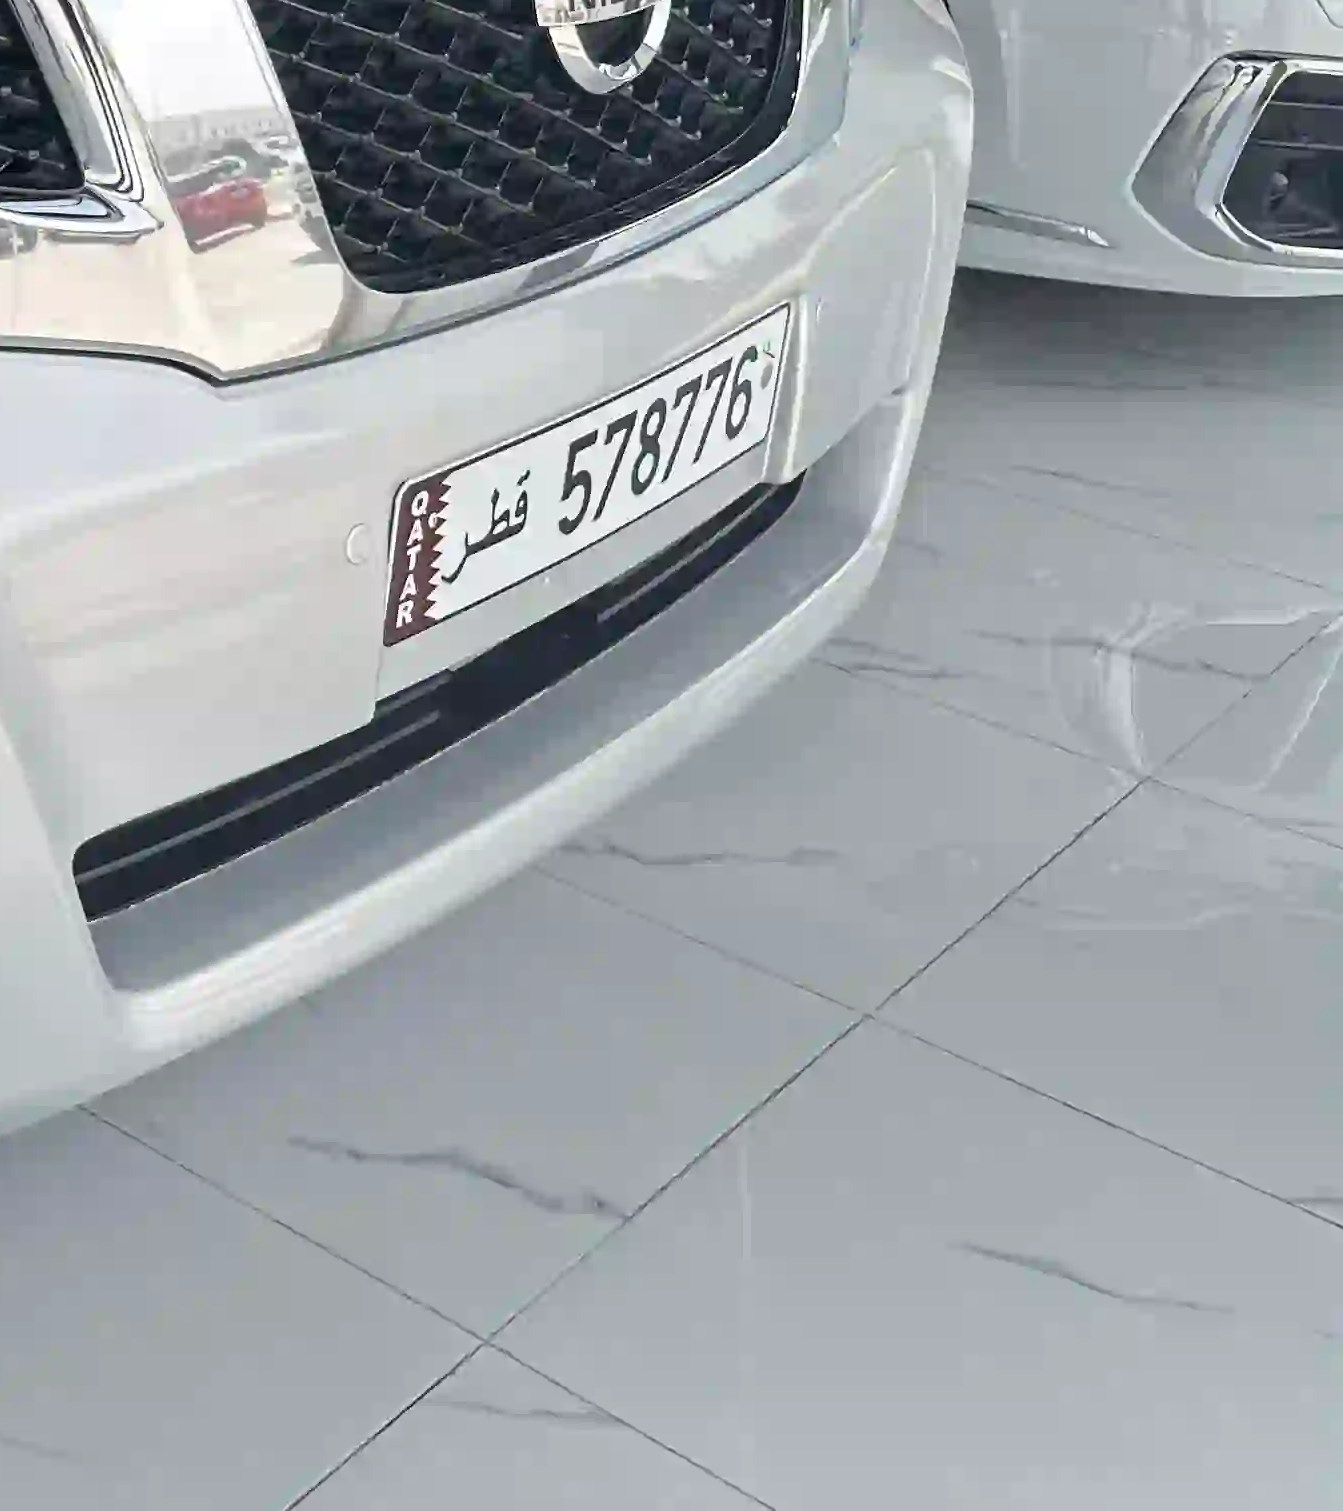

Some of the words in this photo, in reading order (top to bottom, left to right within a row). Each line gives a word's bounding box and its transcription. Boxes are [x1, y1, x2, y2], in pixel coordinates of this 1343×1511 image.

[557, 344, 759, 537] 578776
[394, 490, 429, 629] QATAR
[441, 469, 530, 584] قطر
